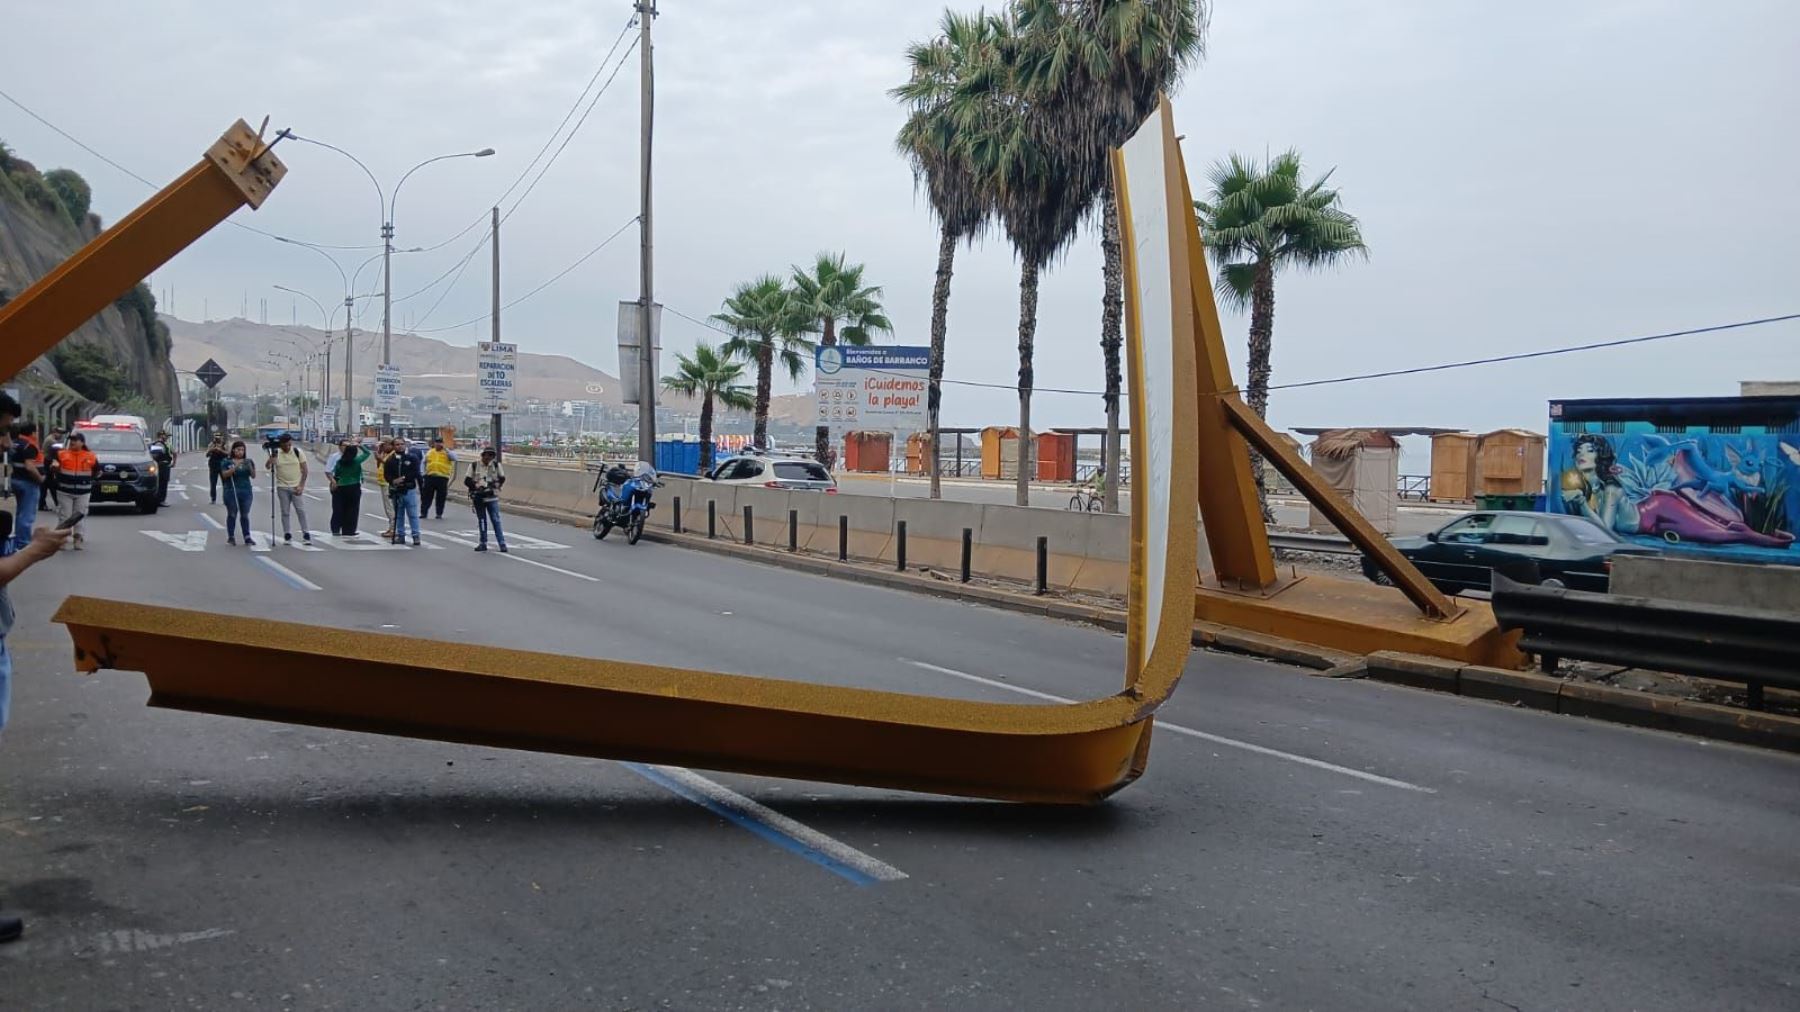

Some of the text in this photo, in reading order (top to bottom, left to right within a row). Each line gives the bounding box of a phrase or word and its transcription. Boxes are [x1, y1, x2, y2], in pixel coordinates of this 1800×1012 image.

[491, 344, 513, 353] LIMA
[846, 355, 928, 365] BAÑOS DE BARRANCO
[864, 376, 925, 391] ¡Cuidemos
[868, 392, 920, 409] la playa!
